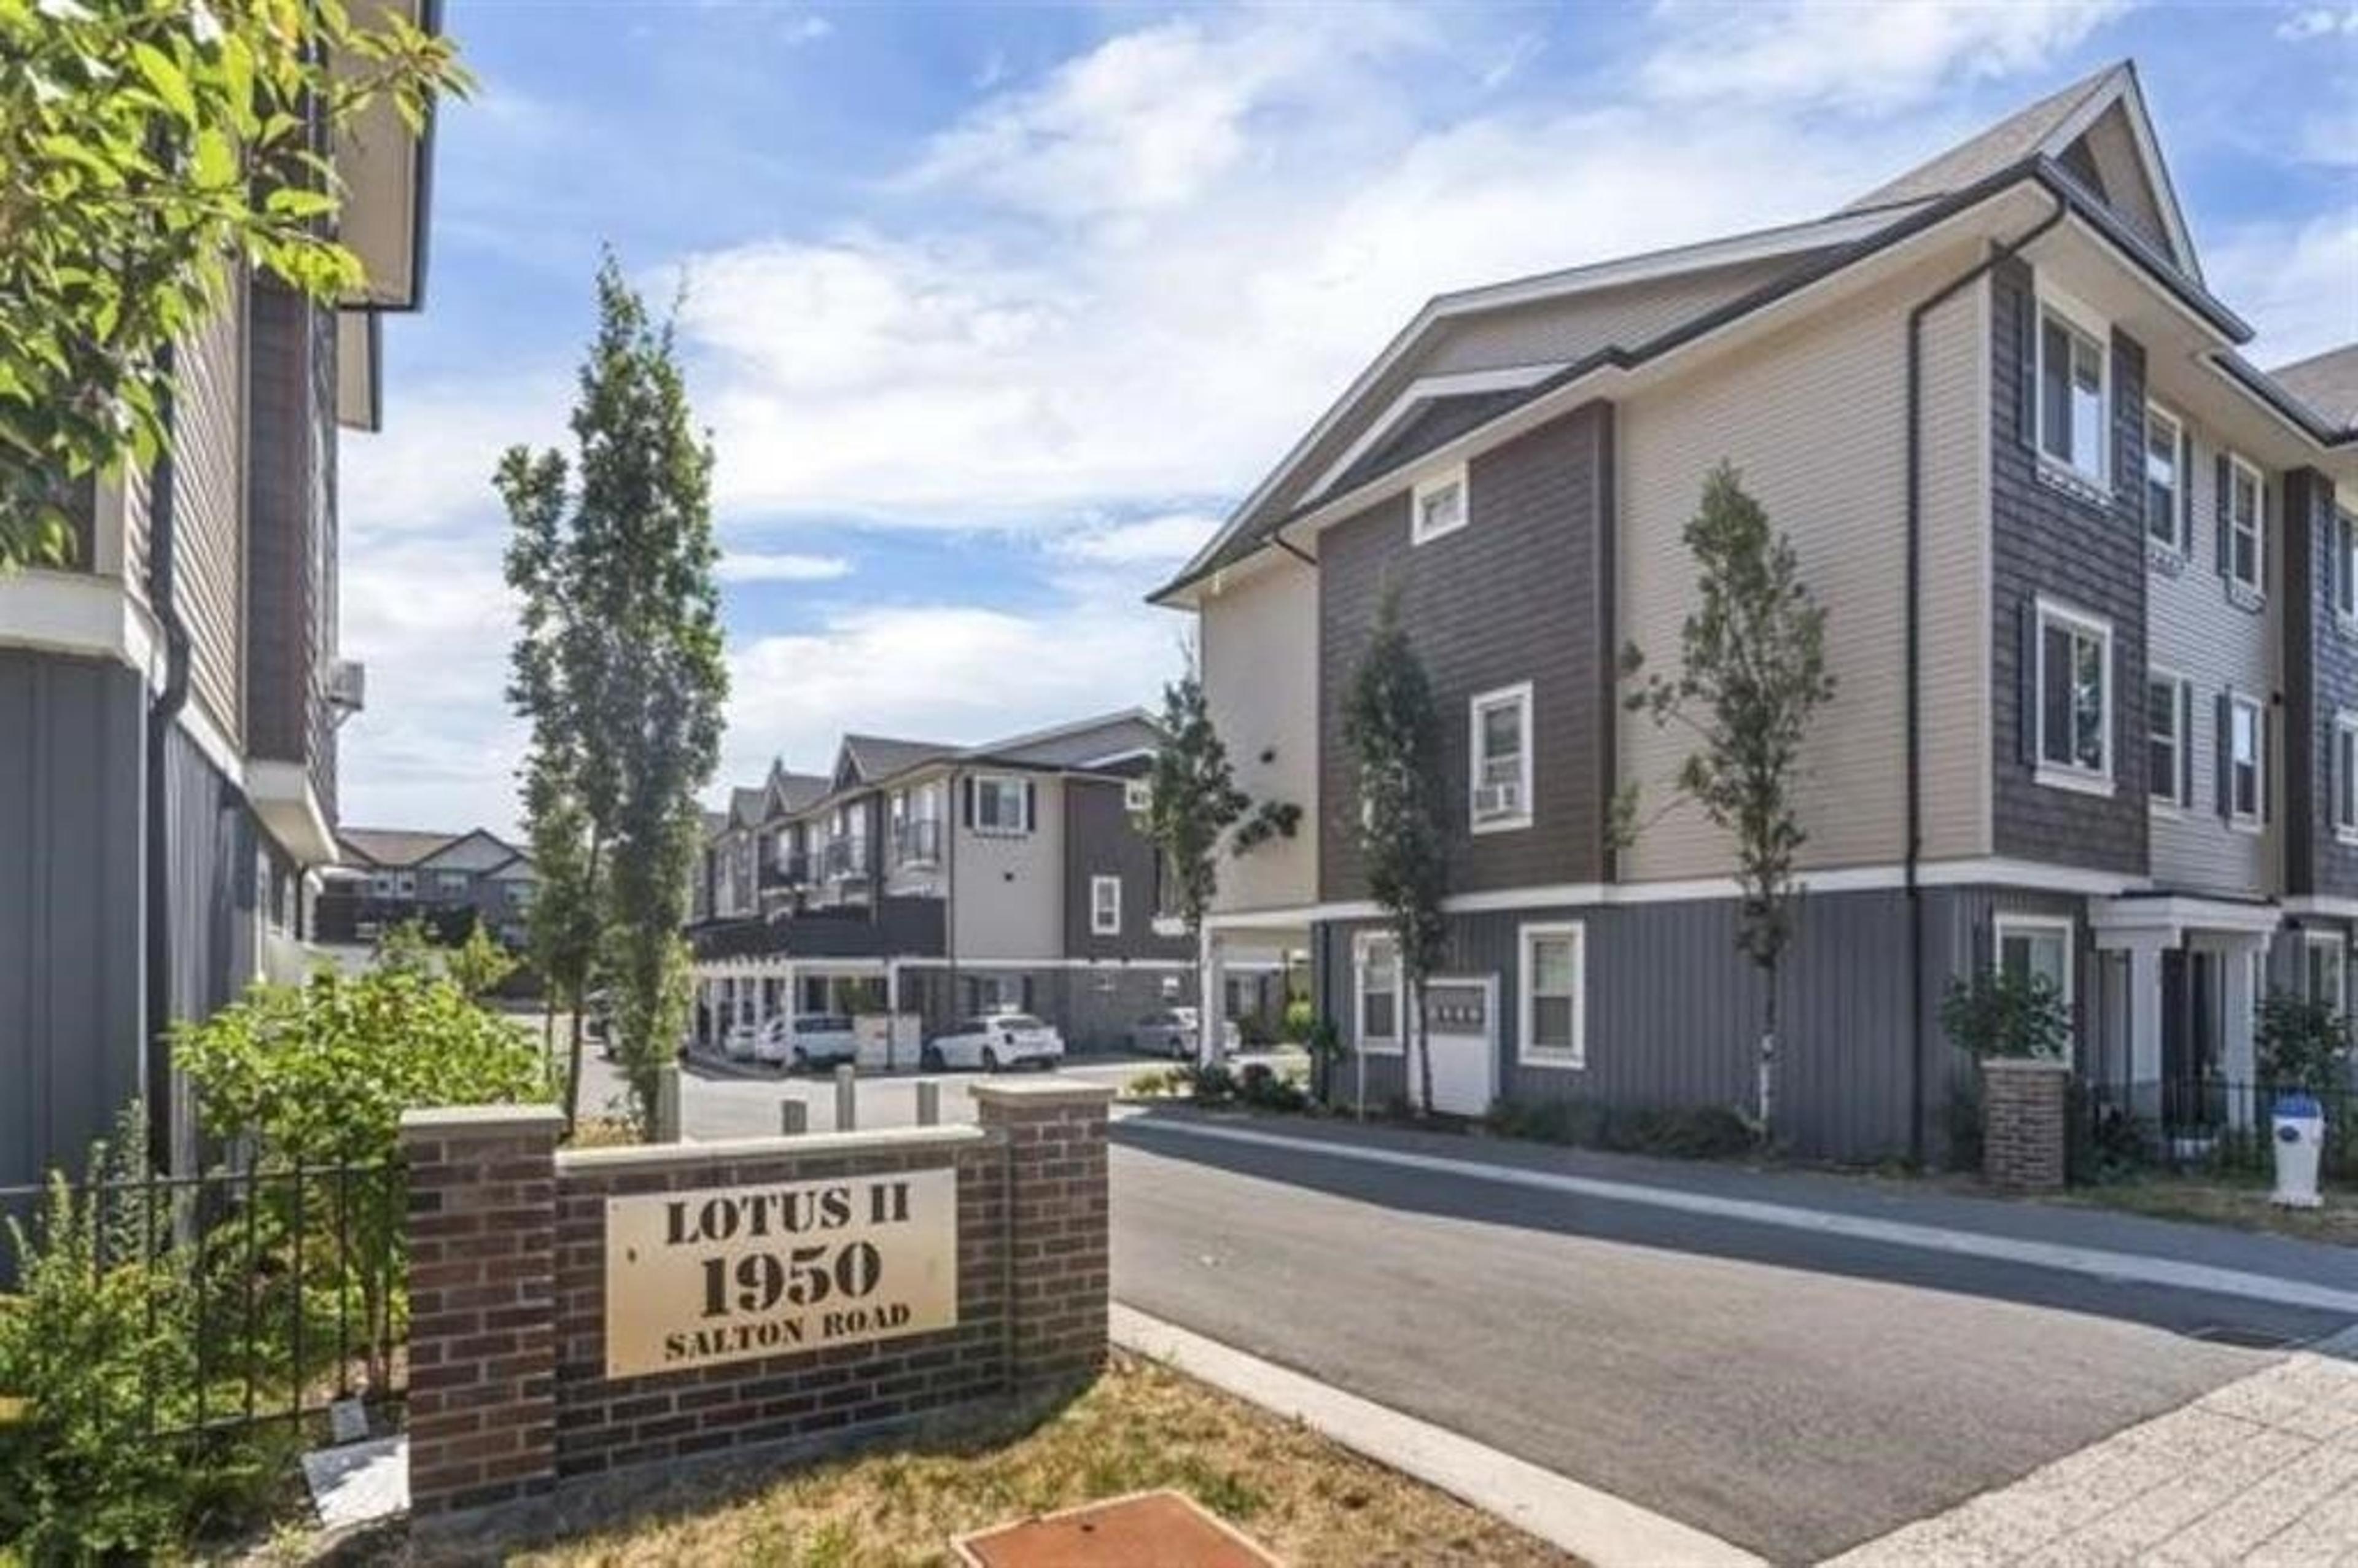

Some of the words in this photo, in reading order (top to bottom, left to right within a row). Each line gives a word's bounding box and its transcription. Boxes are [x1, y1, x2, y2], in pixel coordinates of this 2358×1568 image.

[665, 1187, 852, 1244] LOTUS
[870, 1182, 909, 1224] II
[701, 1241, 881, 1318] 1950
[664, 1317, 804, 1362] SALTON
[823, 1303, 911, 1338] ROAD
